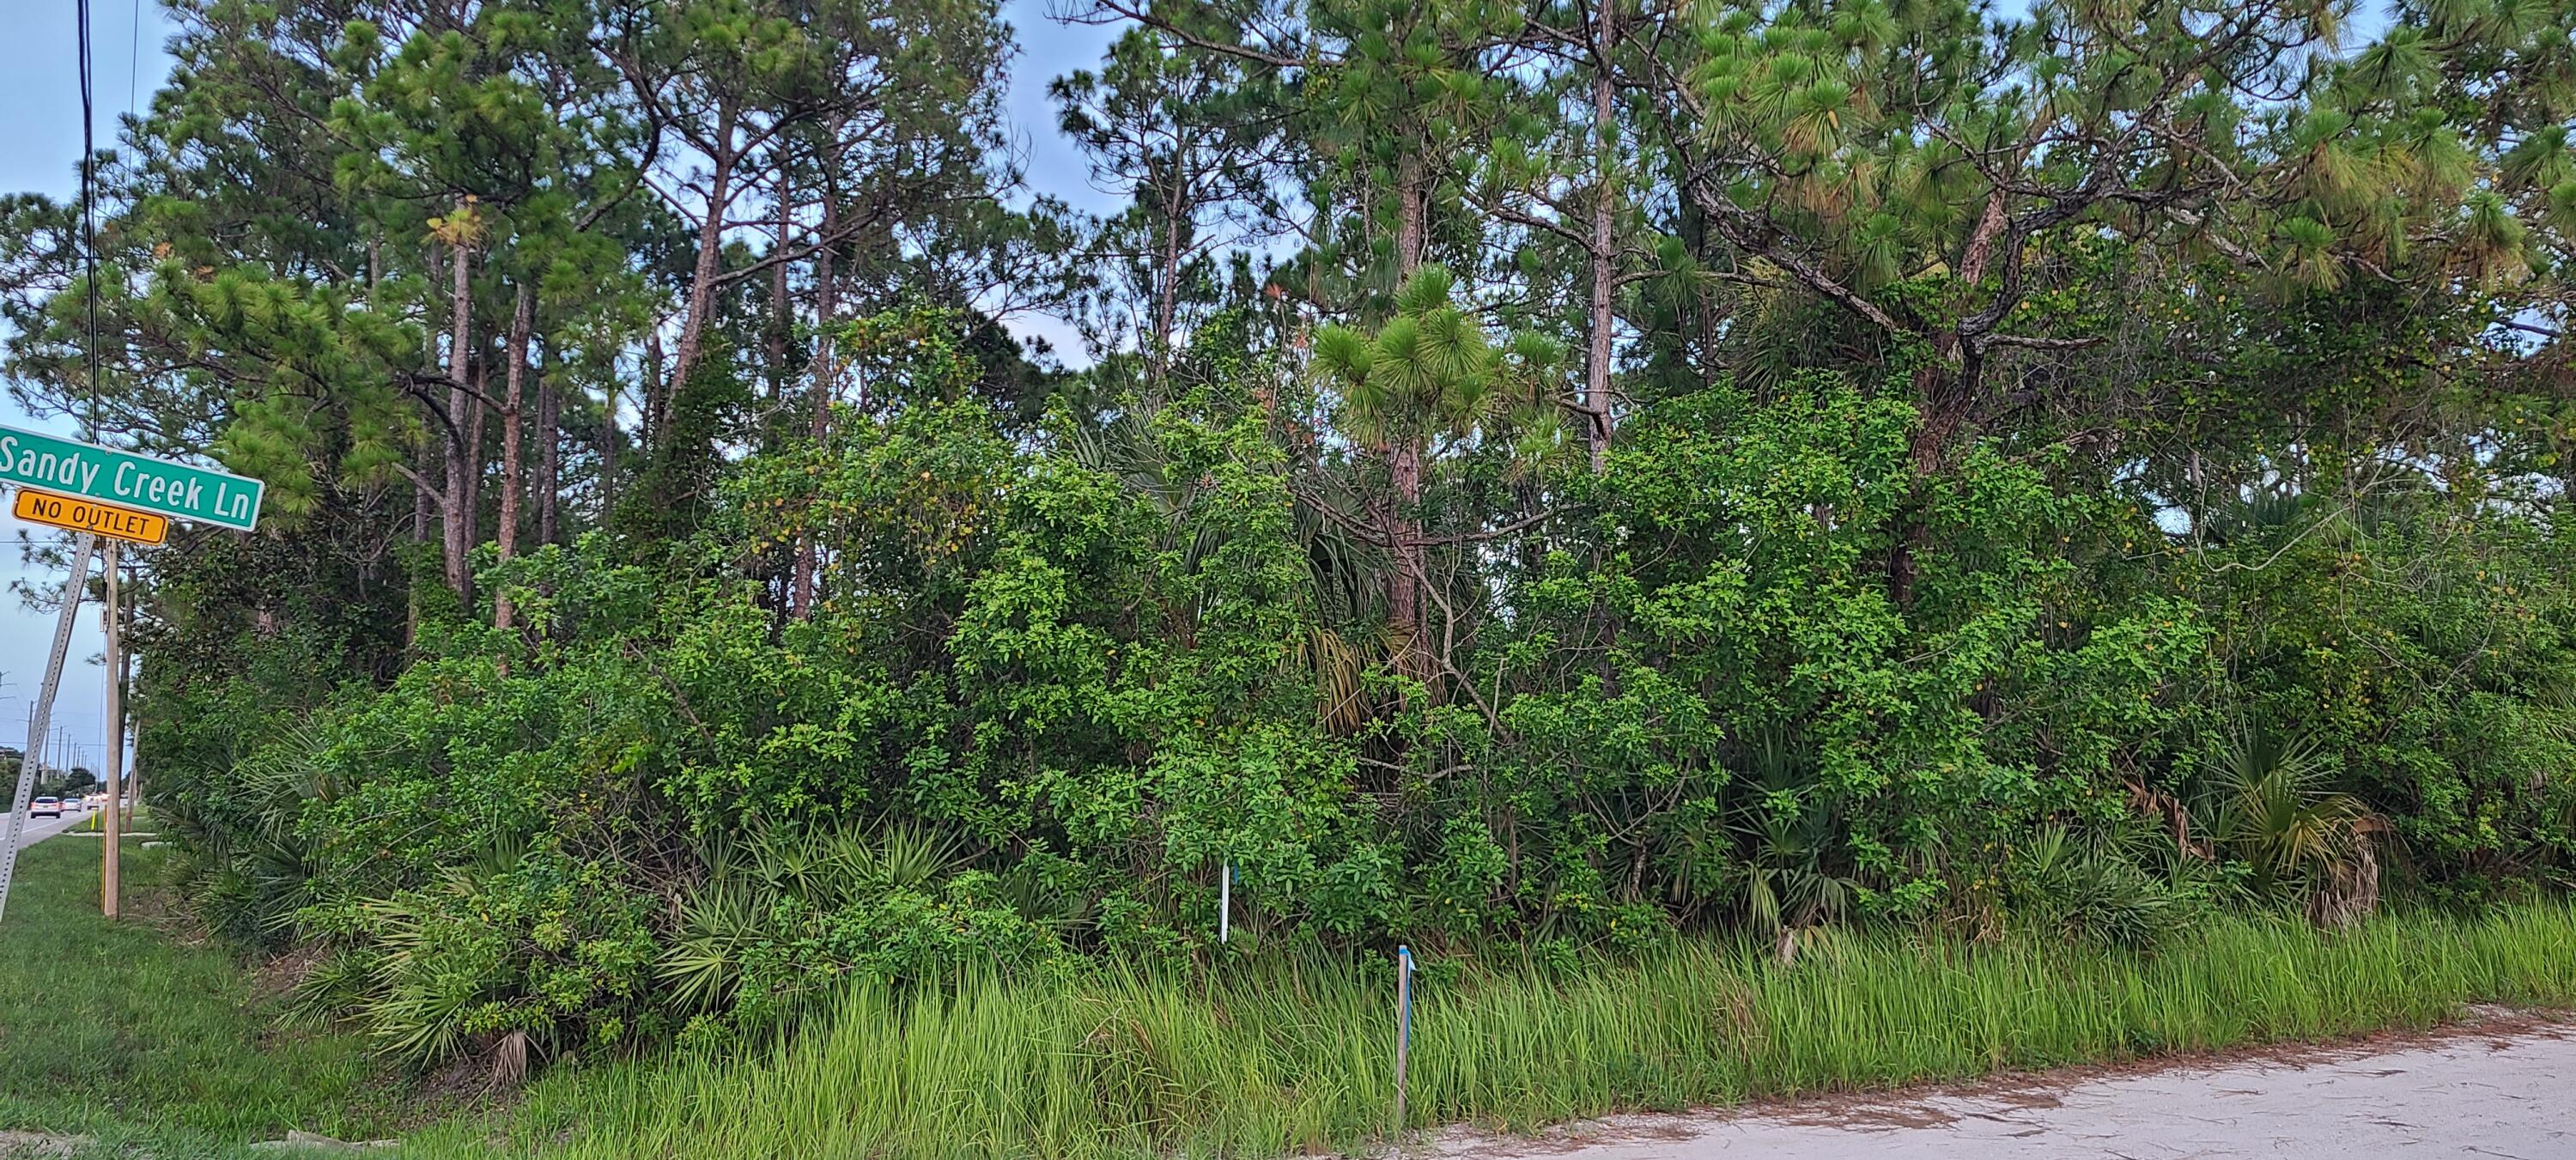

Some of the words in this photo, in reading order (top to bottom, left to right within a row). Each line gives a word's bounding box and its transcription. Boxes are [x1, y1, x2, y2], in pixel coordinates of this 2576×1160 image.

[0, 436, 100, 493] Sandy
[114, 462, 203, 510] Creek
[215, 483, 249, 519] Ln
[33, 498, 62, 518] NO
[74, 506, 149, 535] OUTLET
